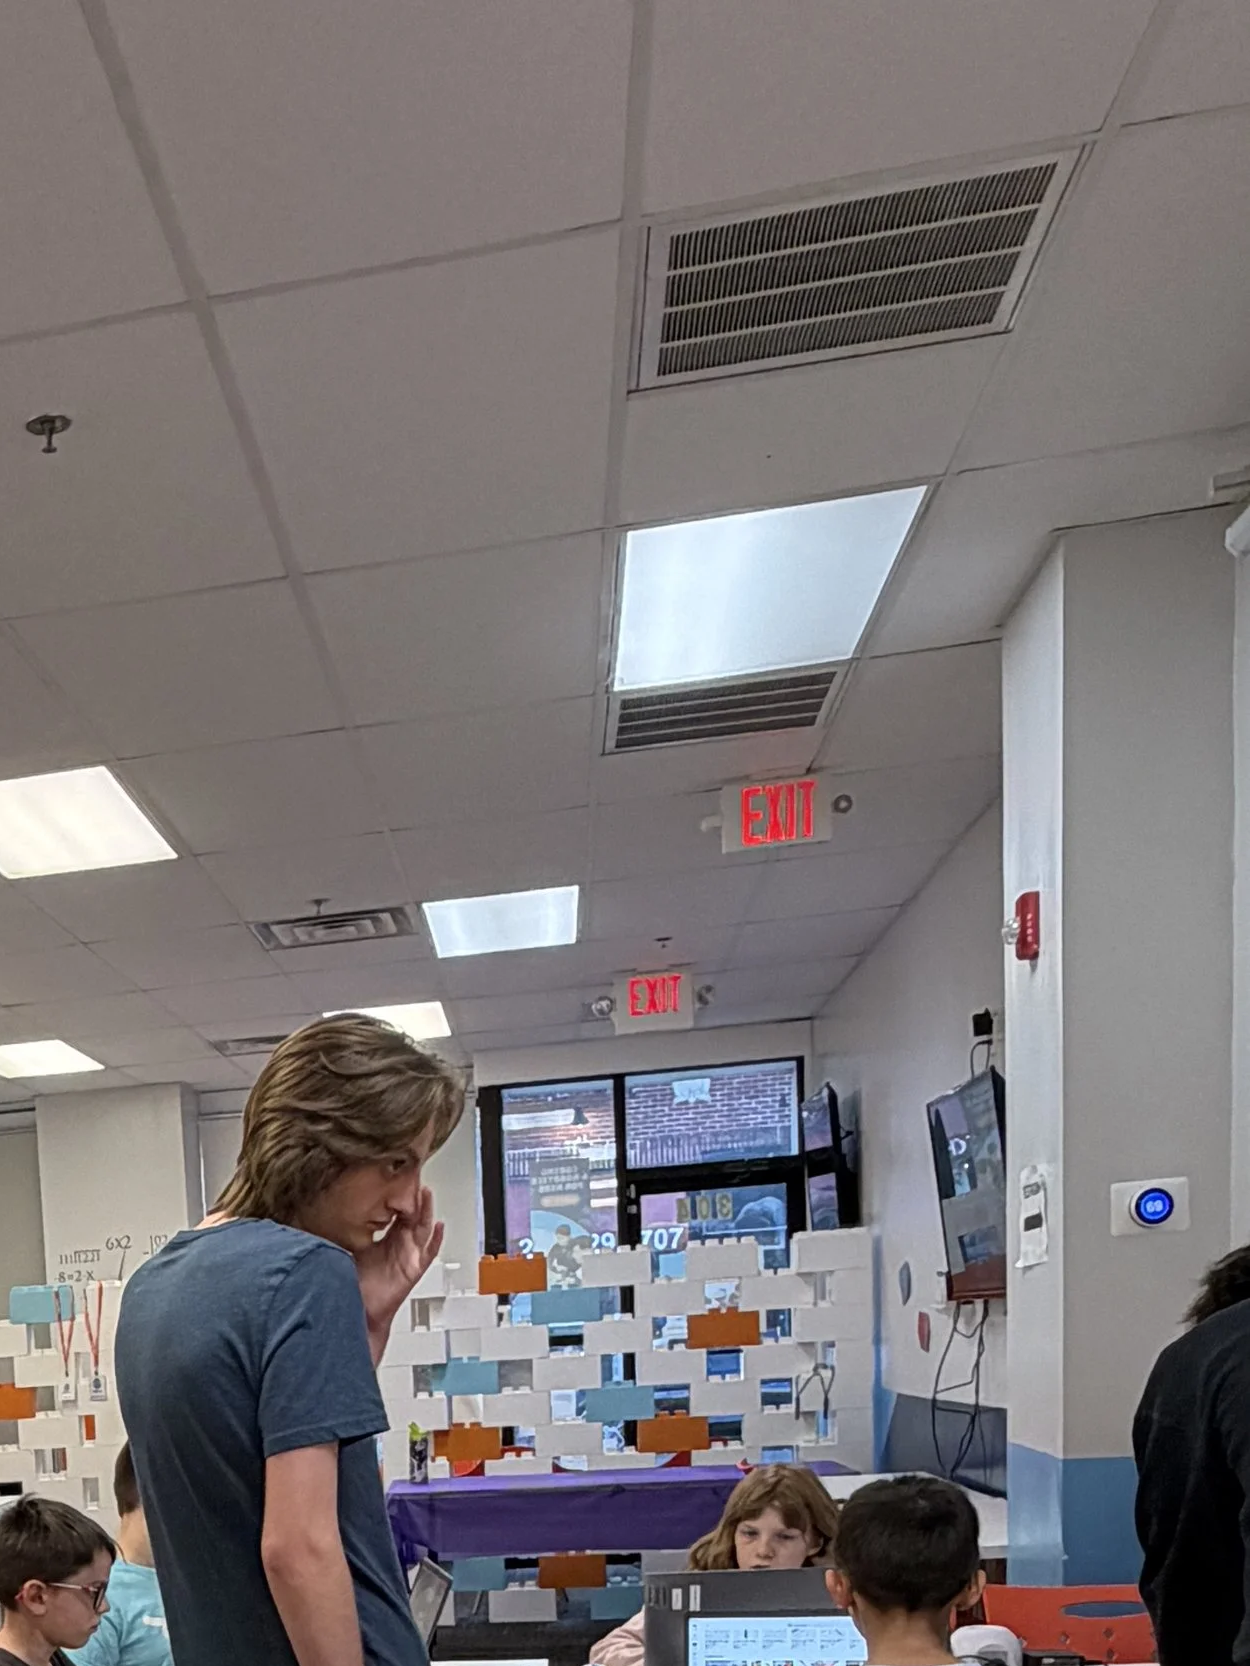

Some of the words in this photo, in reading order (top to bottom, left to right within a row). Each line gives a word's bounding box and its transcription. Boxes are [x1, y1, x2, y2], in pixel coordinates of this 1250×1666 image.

[740, 779, 817, 848] EXIT
[627, 973, 682, 1018] EXIT
[640, 1227, 684, 1251] 707
